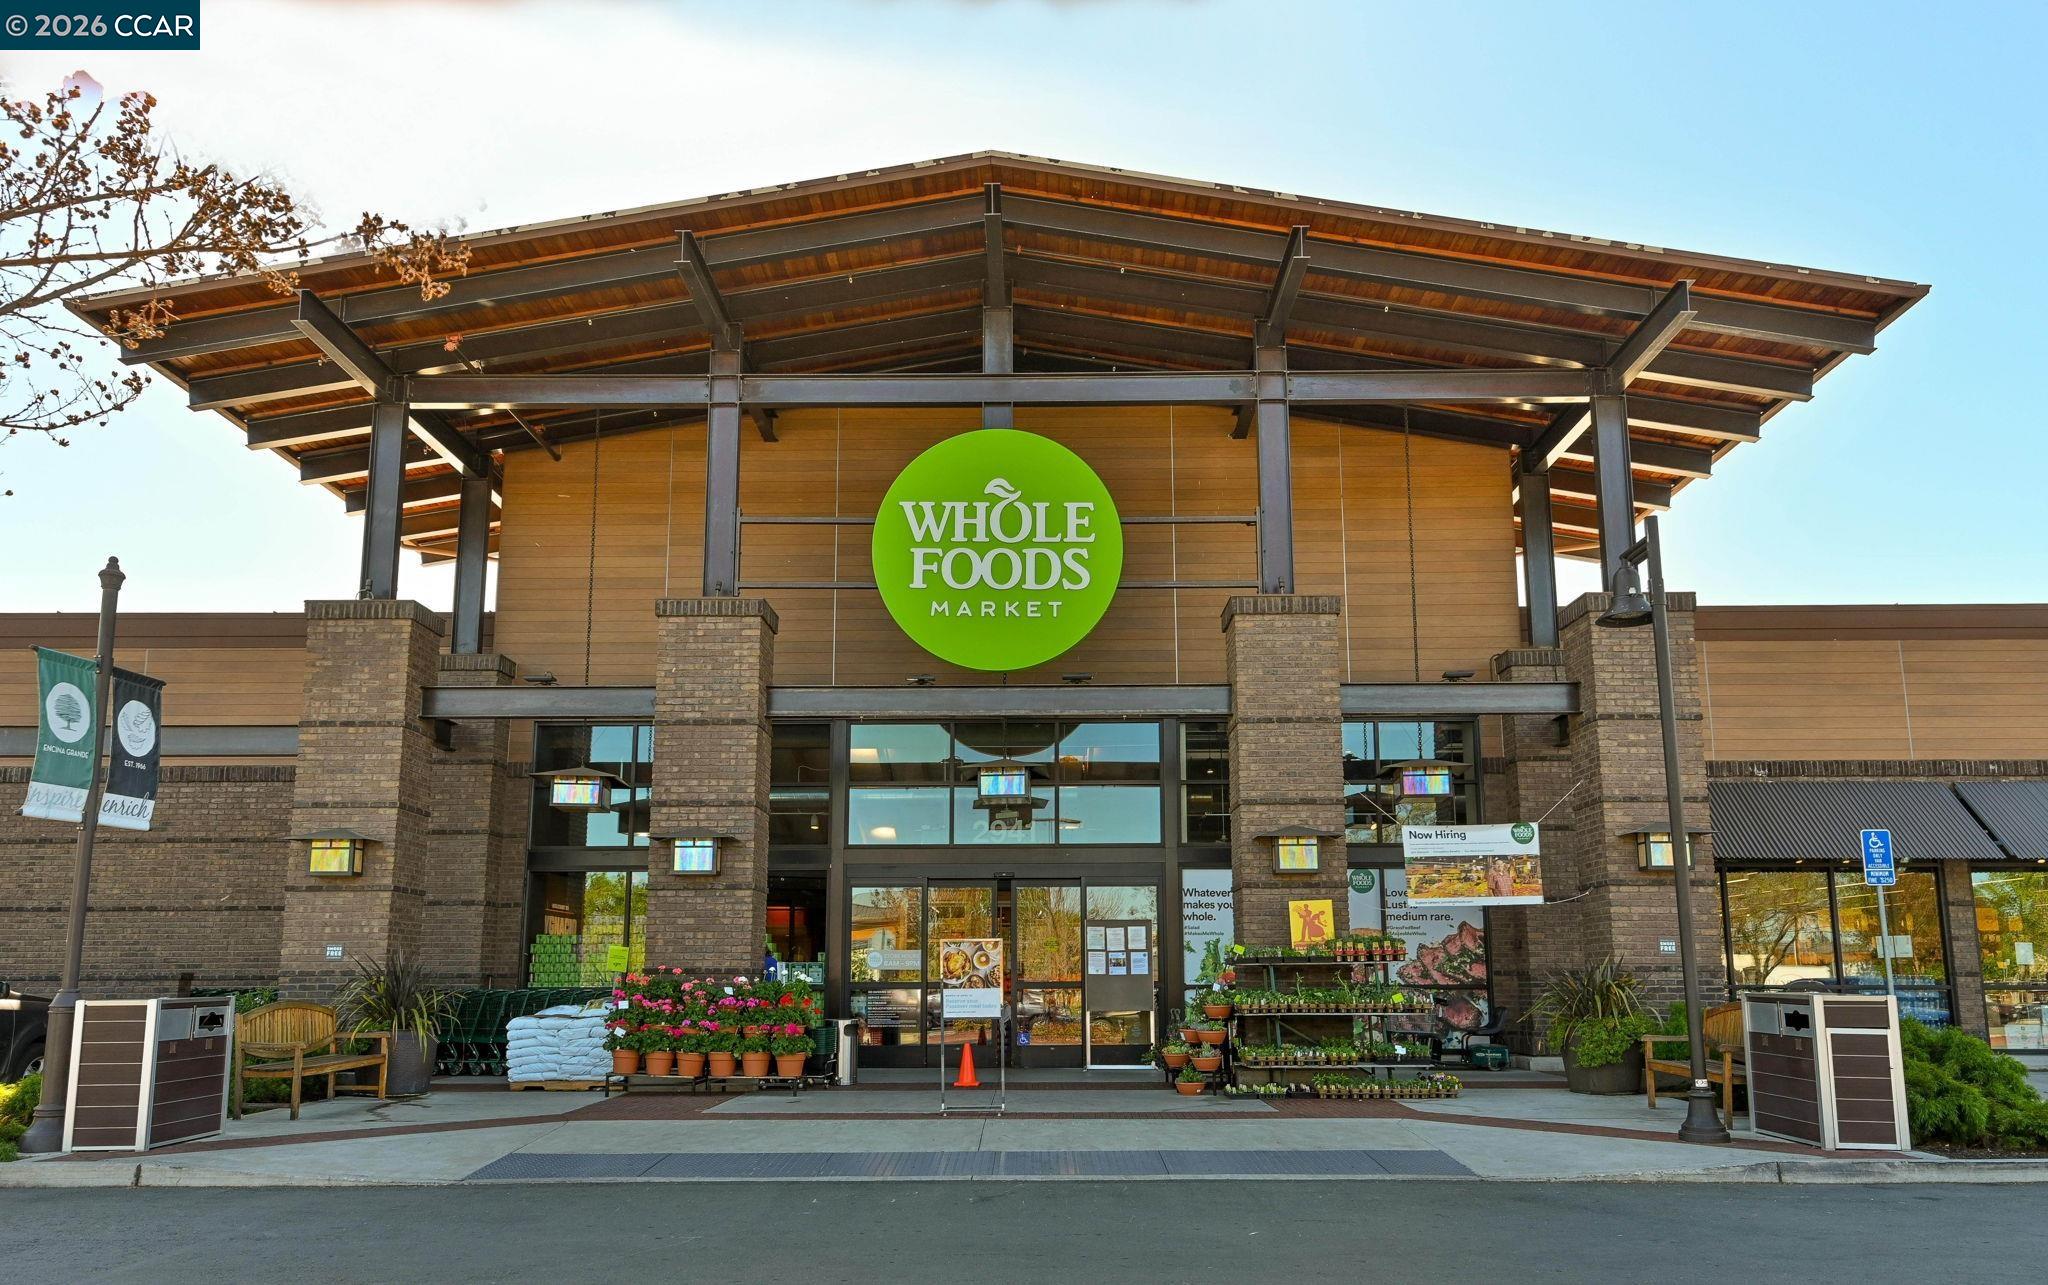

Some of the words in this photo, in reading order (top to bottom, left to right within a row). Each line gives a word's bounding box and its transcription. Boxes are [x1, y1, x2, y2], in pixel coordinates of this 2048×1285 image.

[899, 494, 1096, 543] WHOLE
[908, 547, 1091, 590] FOODS
[930, 600, 1062, 617] MARKET
[43, 744, 66, 756] ENCINA
[66, 748, 89, 760] GRANDE
[124, 759, 135, 768] EST.
[102, 791, 149, 819] enrich
[1512, 825, 1533, 833] WHOLE
[1409, 830, 1433, 839] Now
[1435, 830, 1467, 841] Hiring
[1182, 888, 1233, 897] Whatever
[1183, 900, 1216, 909] makes
[1386, 900, 1407, 909] Lust
[1183, 911, 1216, 921] whole.
[1386, 911, 1428, 921] medium
[1430, 913, 1454, 921] rare.
